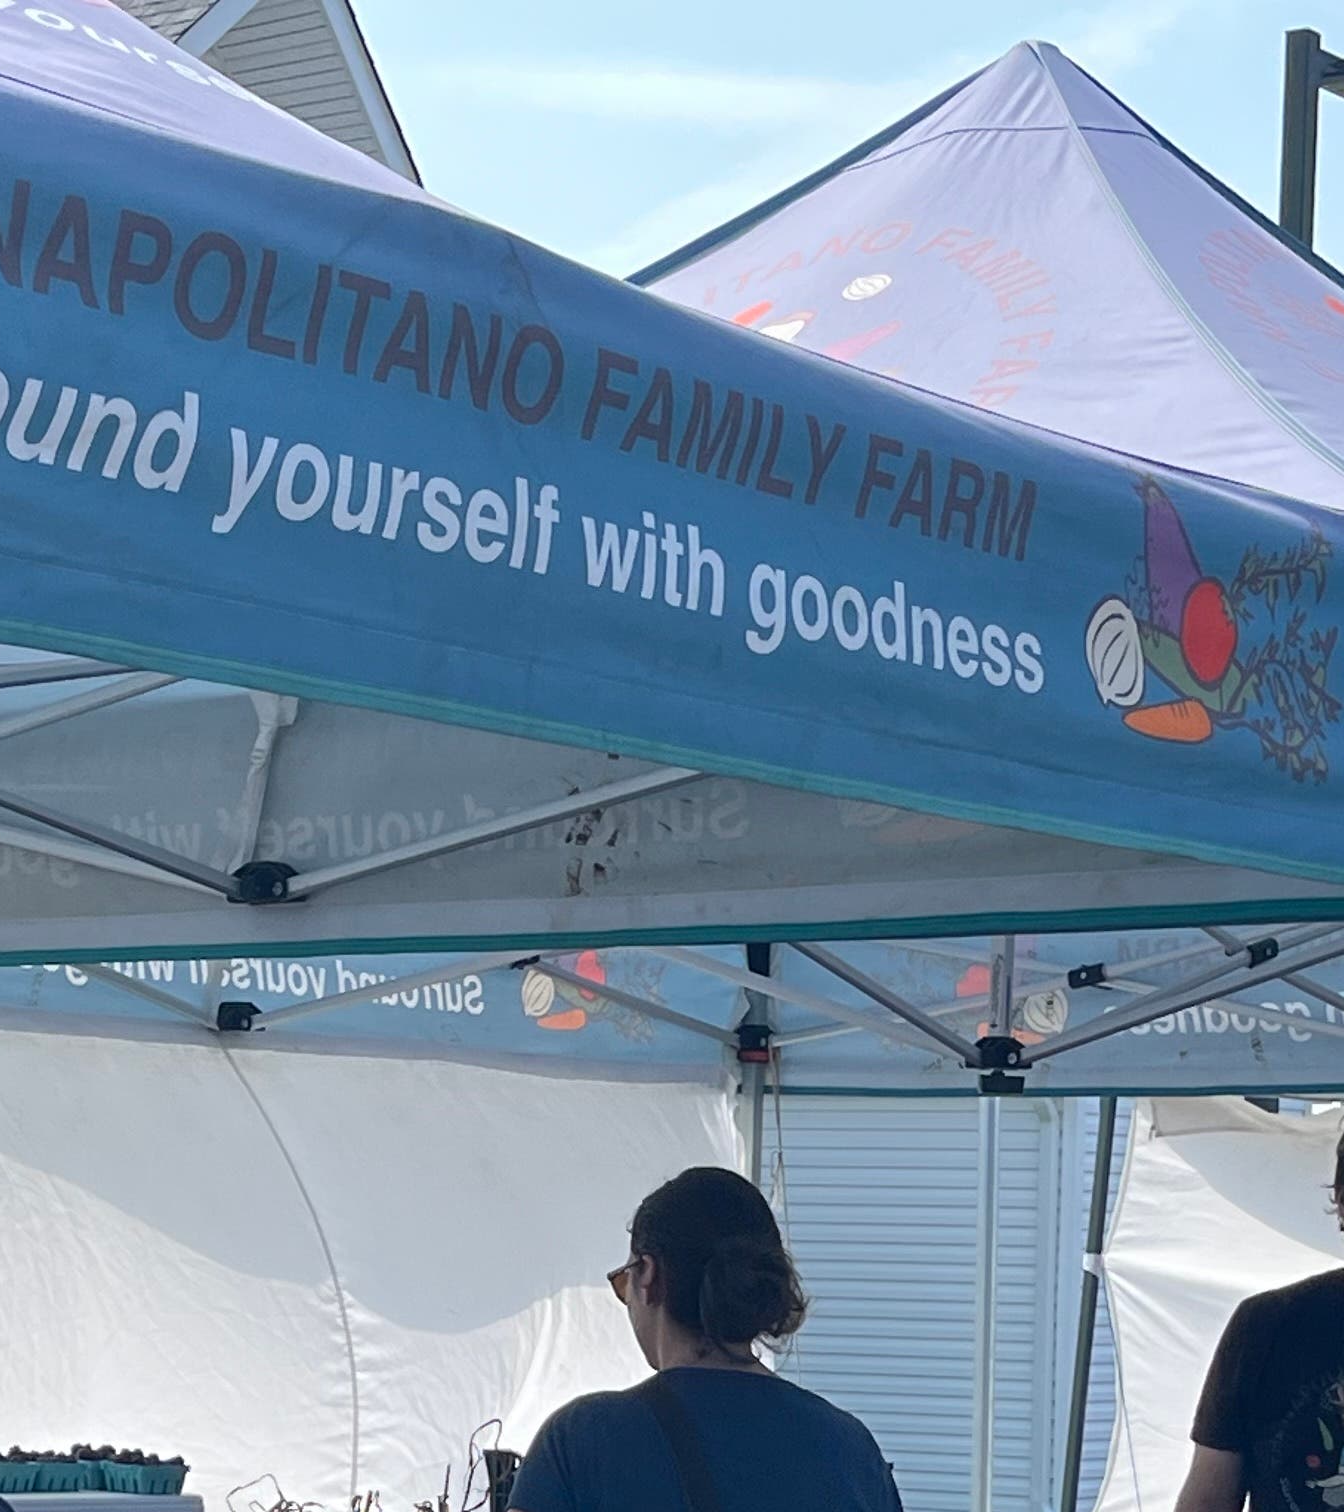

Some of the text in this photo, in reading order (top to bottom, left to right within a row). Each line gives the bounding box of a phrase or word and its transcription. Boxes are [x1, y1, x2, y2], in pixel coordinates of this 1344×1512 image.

[211, 427, 560, 576] yourself
[581, 511, 726, 617] with
[745, 562, 1045, 694] goodness
[581, 347, 845, 505] FAMILY
[856, 434, 1037, 562] FARM
